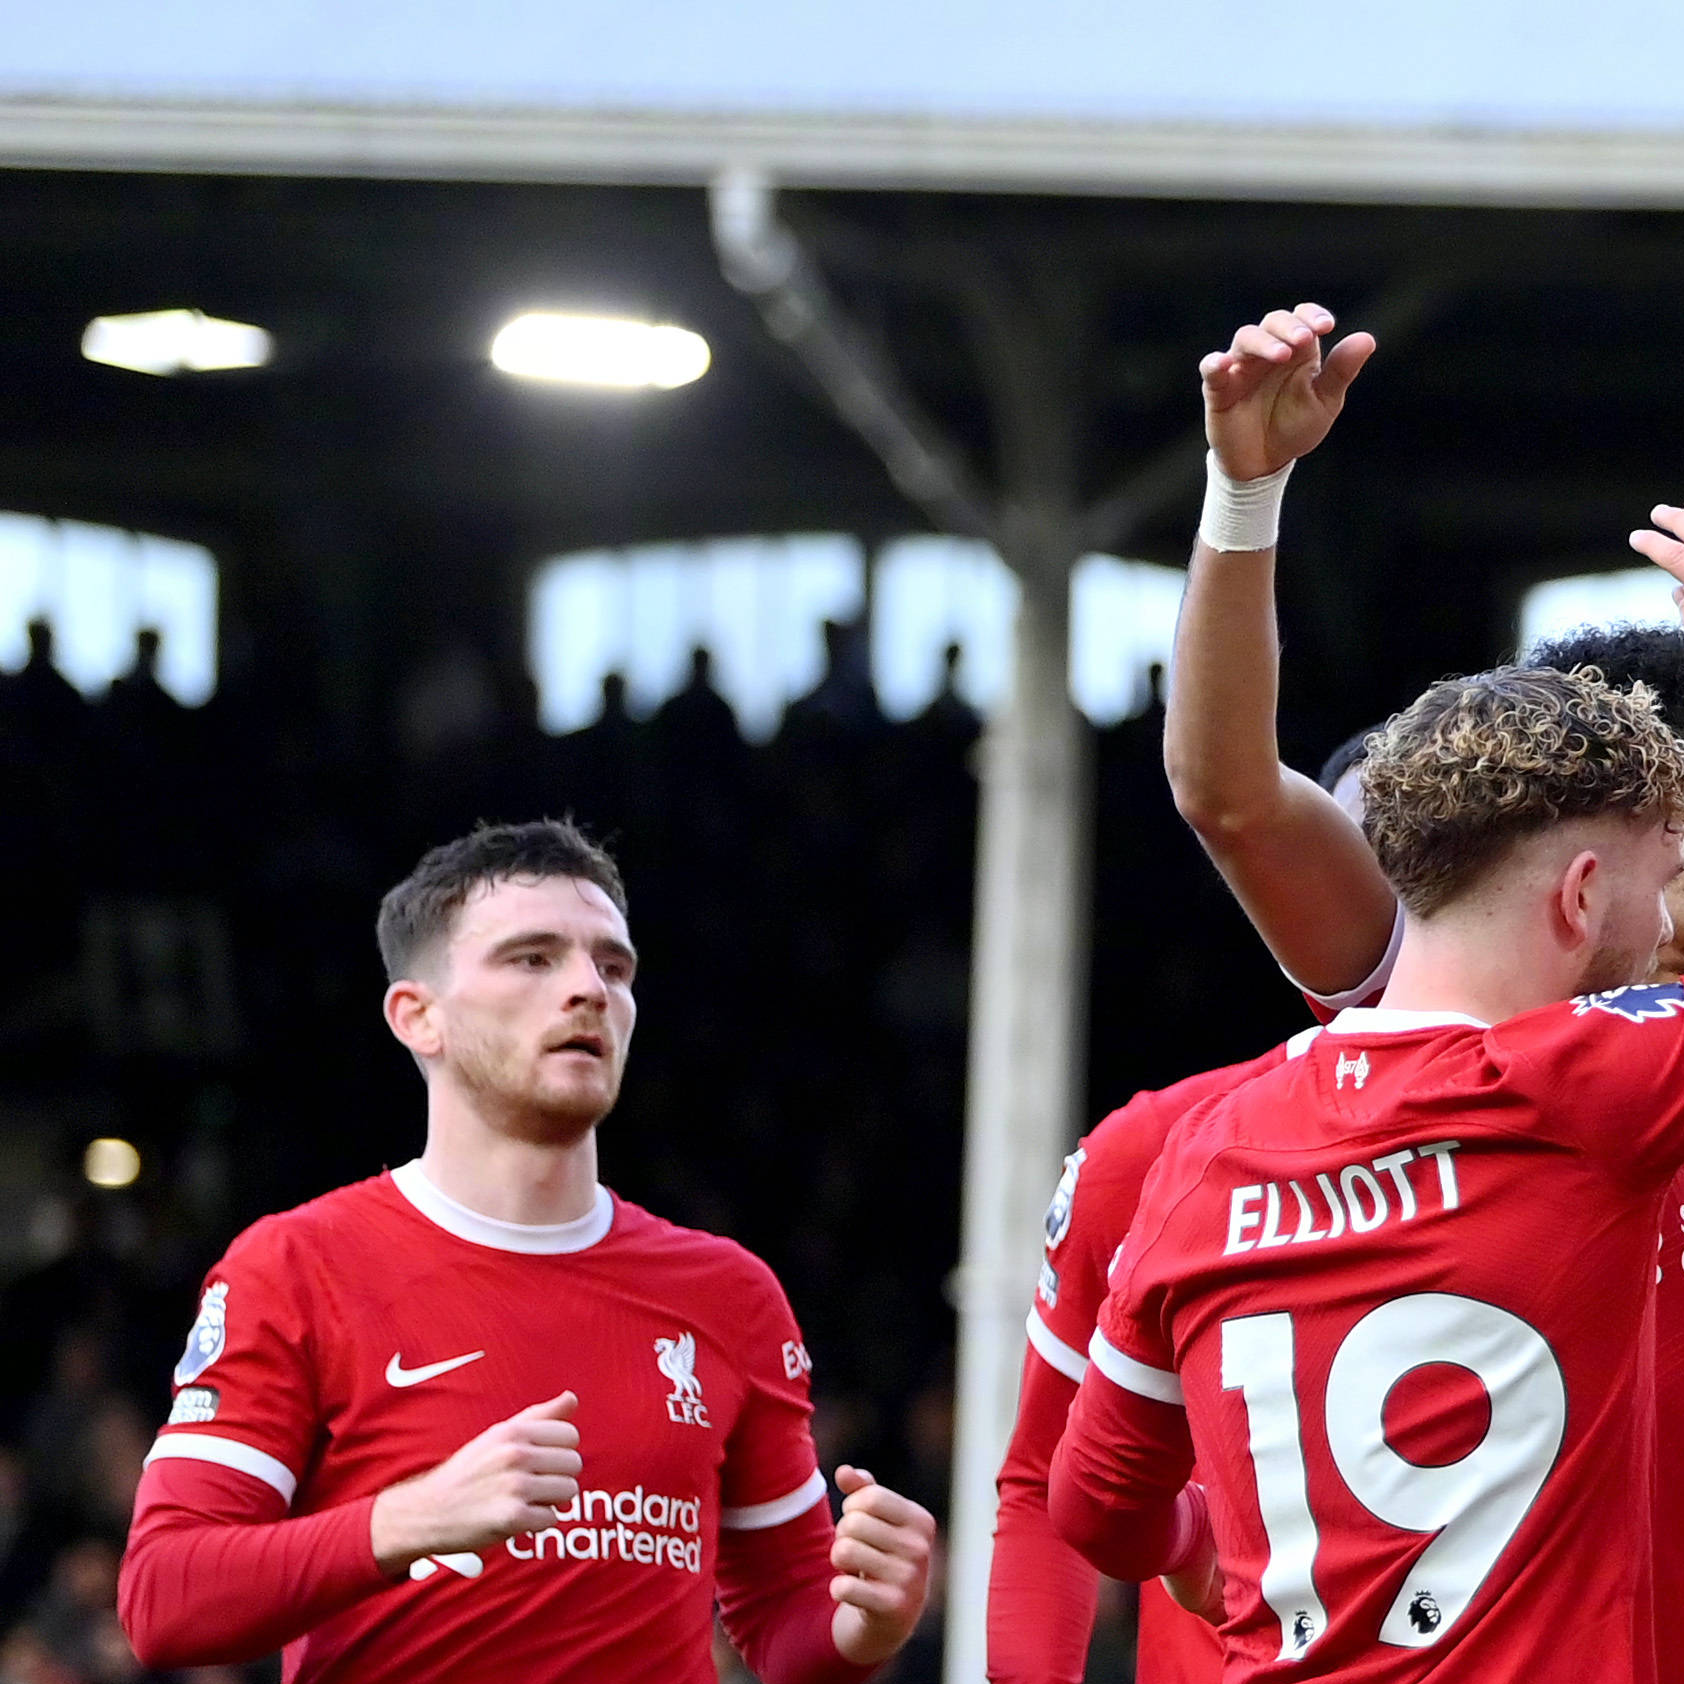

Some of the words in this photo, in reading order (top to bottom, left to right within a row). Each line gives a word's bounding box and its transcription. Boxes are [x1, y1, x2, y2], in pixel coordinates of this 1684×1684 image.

[1223, 1140, 1461, 1256] ELLIOTT
[551, 1484, 702, 1534] andard
[1221, 1292, 1567, 1662] 19
